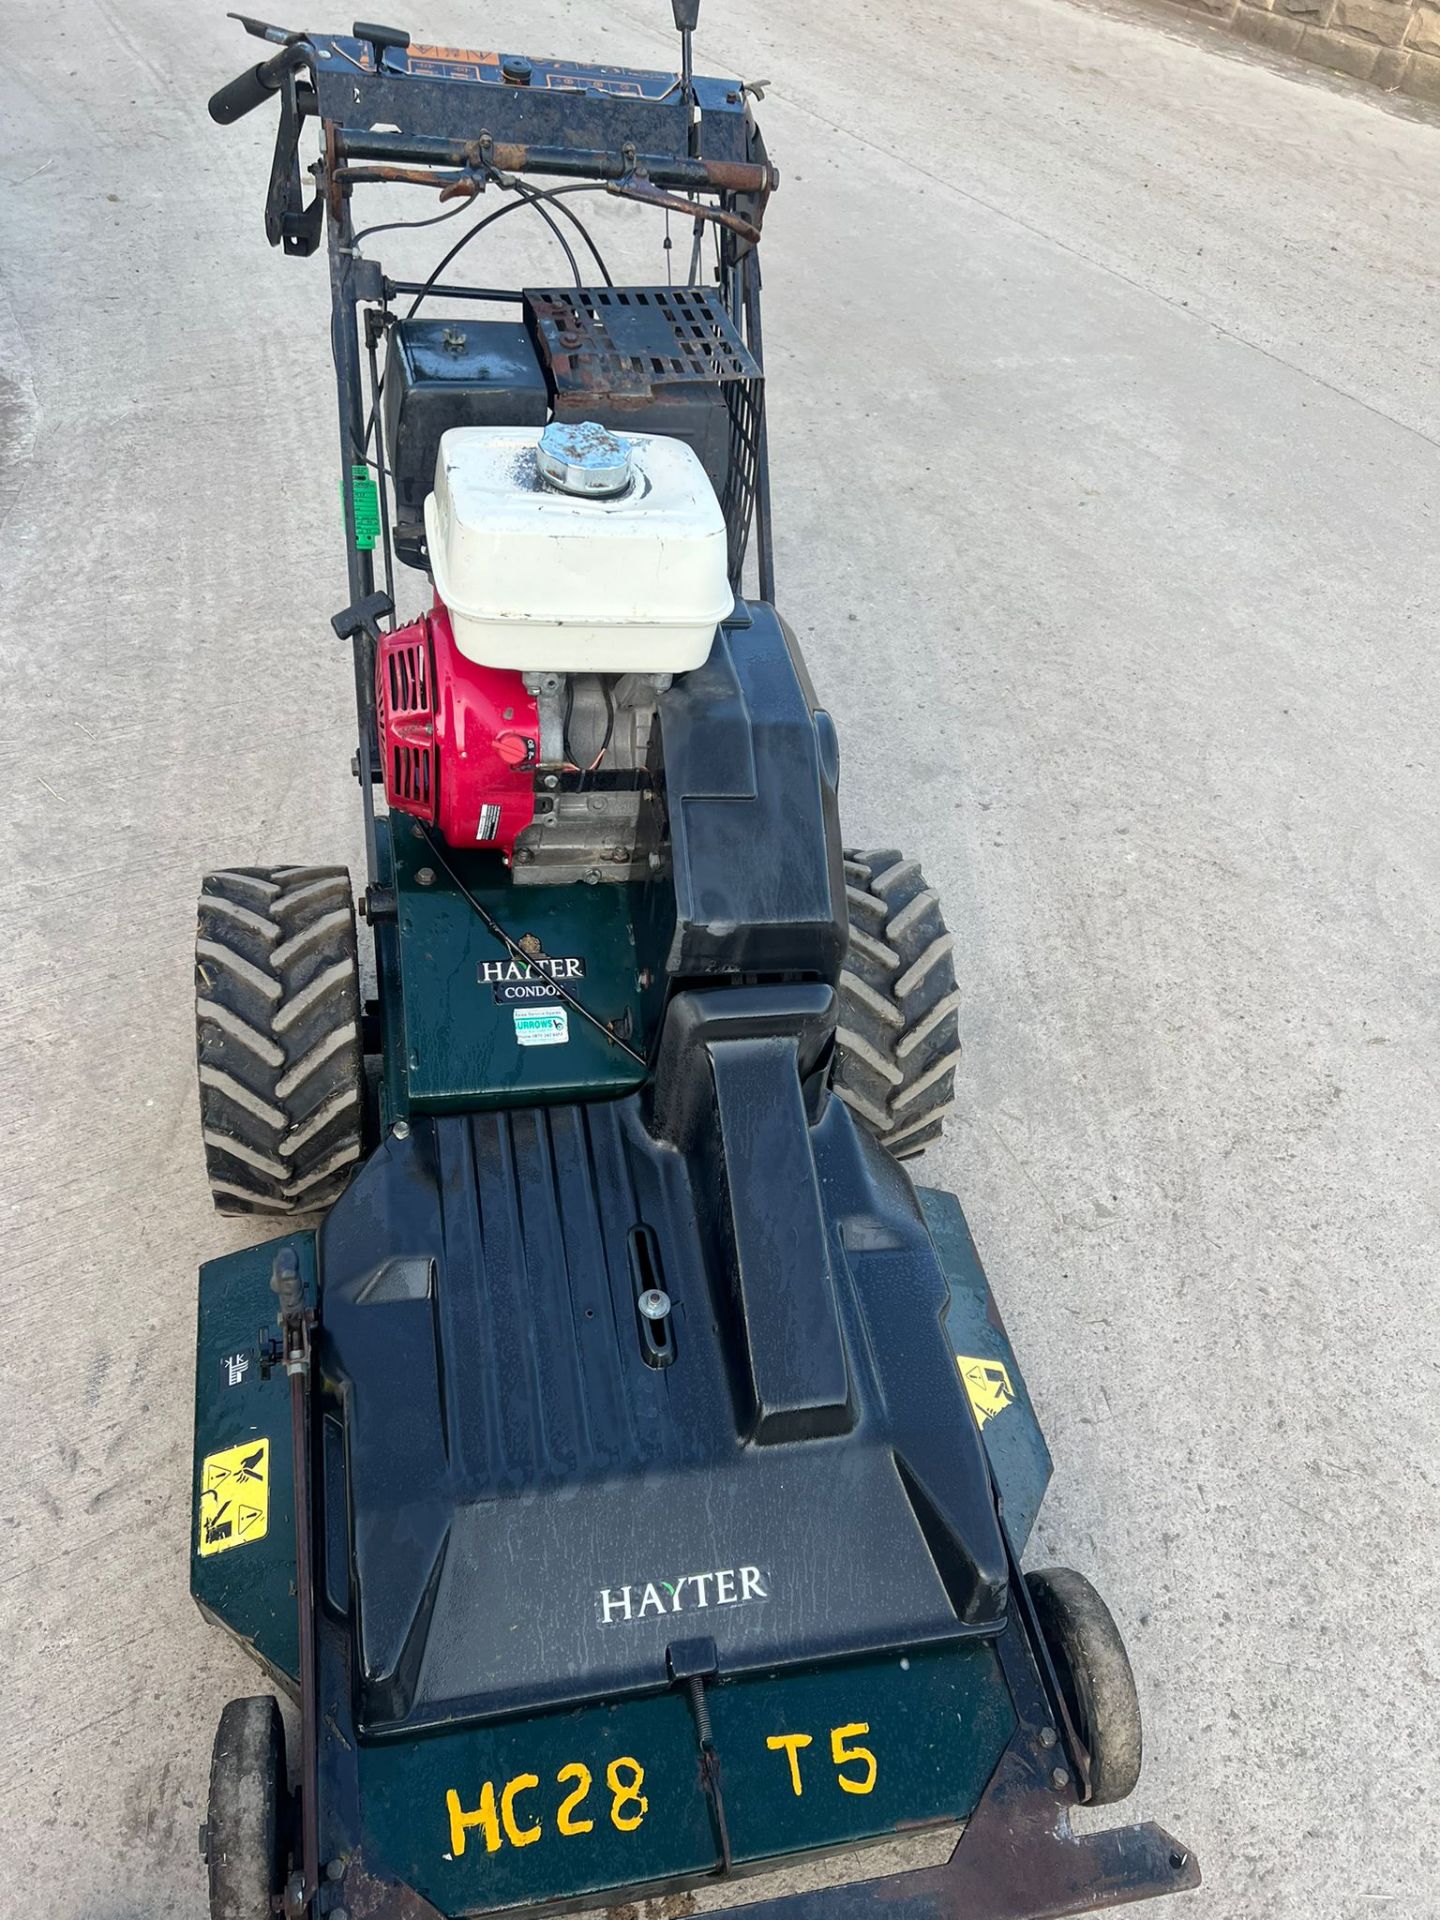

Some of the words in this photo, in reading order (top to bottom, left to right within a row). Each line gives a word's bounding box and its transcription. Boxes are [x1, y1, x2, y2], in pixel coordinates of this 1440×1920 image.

[482, 958, 584, 981] HAYTER
[505, 985, 564, 998] CONDO
[516, 1019, 553, 1030] URROWS
[599, 1566, 767, 1624] HAYTER
[445, 1756, 648, 1856] HC28
